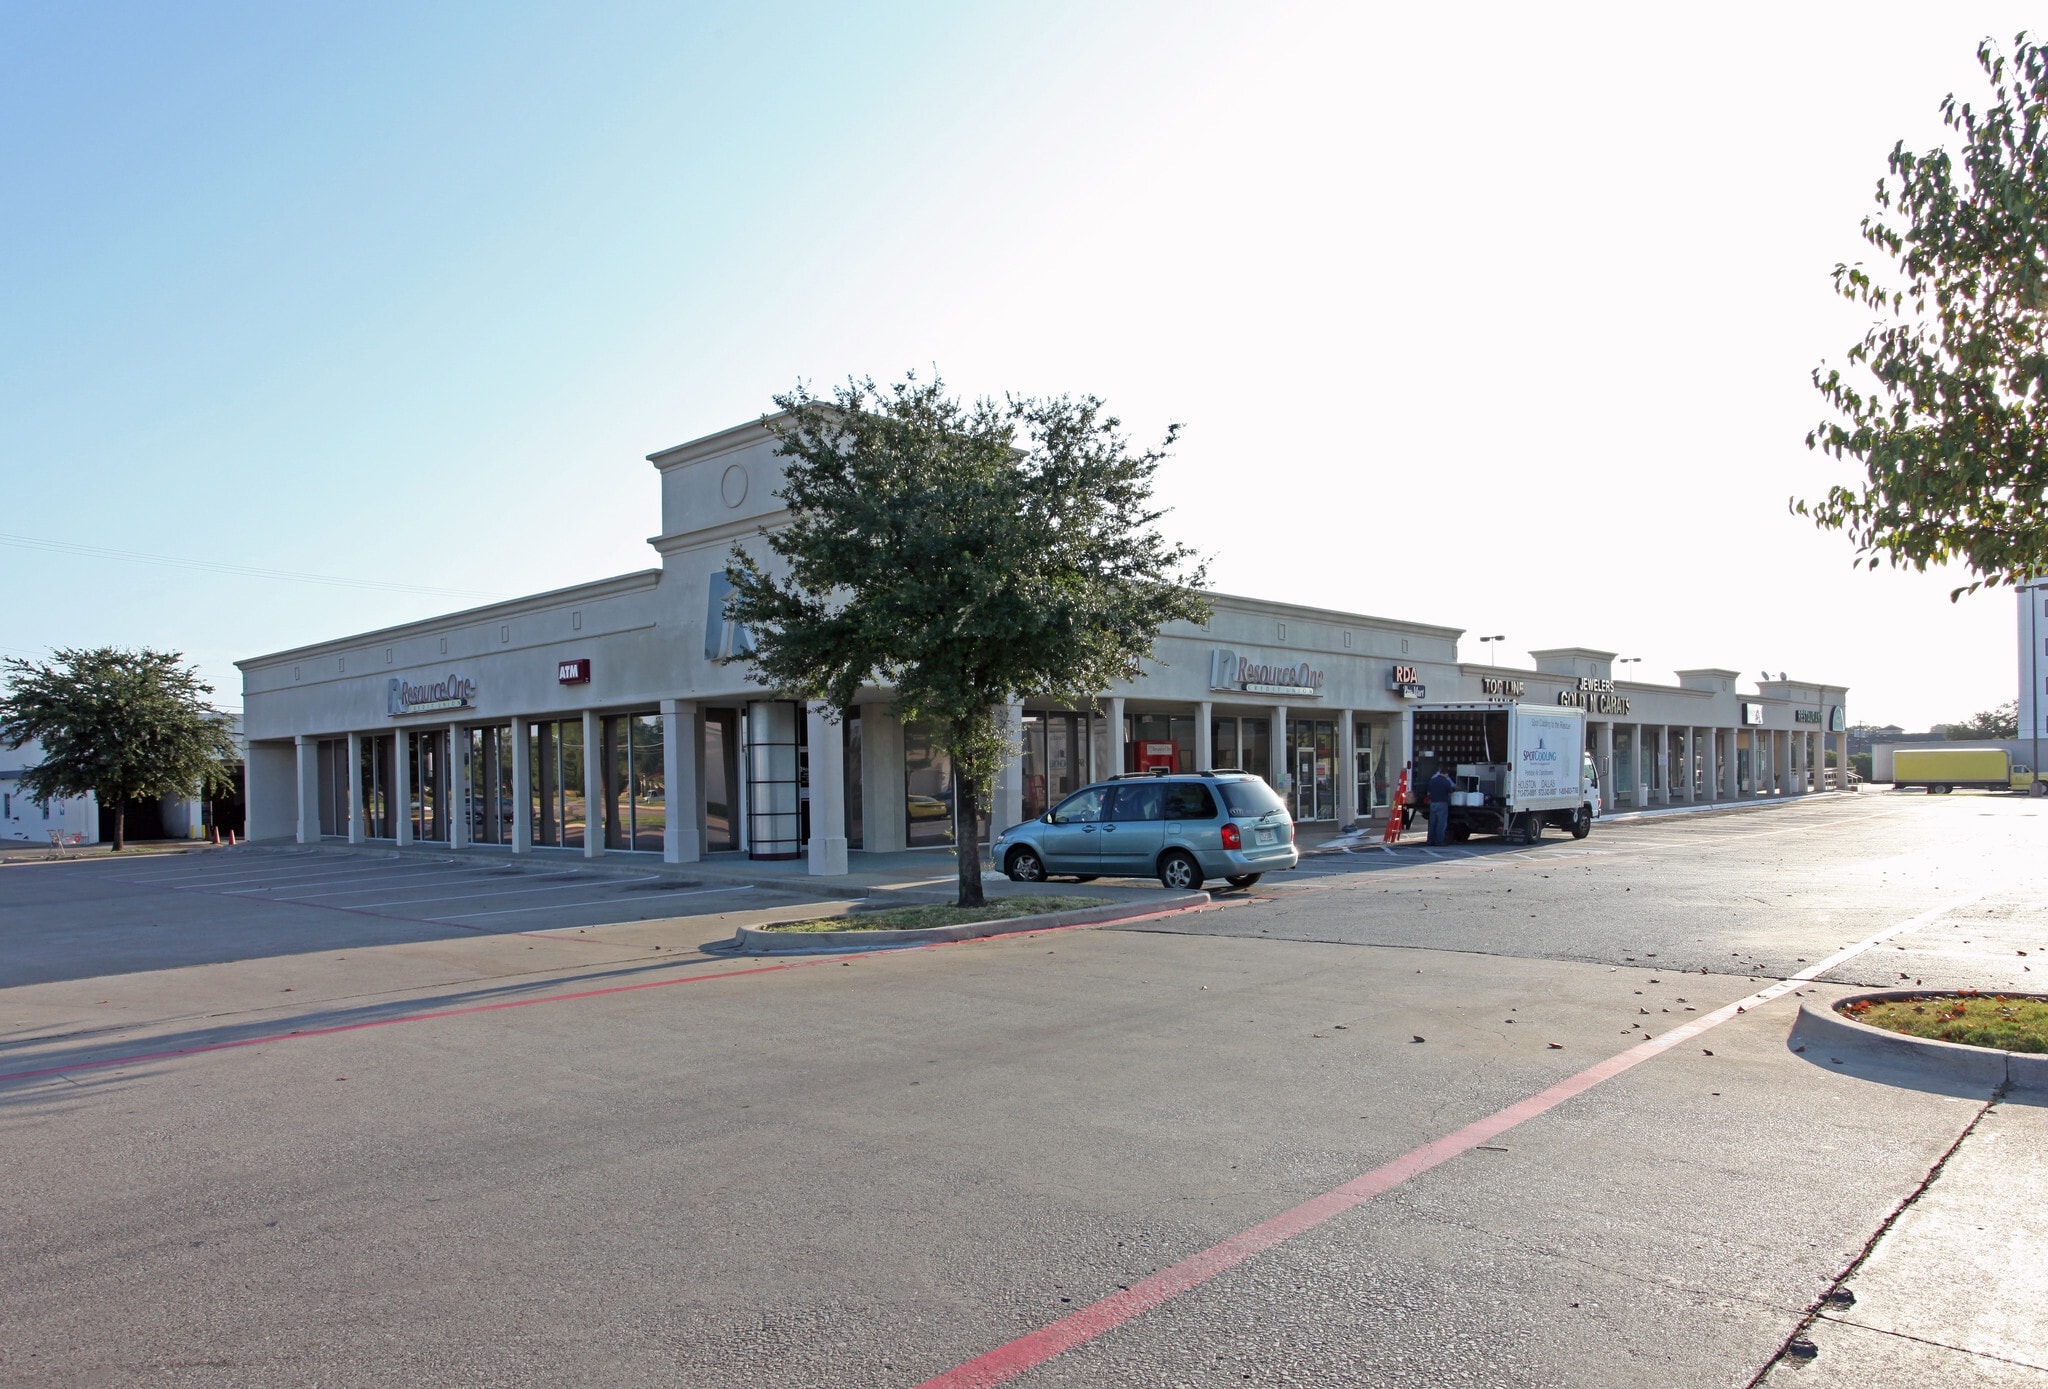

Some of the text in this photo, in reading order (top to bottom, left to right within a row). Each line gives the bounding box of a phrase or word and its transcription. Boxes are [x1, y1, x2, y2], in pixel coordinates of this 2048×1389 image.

[559, 664, 579, 680] ATM
[1396, 665, 1418, 684] RDA
[1247, 684, 1281, 693] CREDIT
[1485, 678, 1525, 698] TOP LINE
[1578, 677, 1615, 693] JEWELERS
[1561, 691, 1586, 709] GOLD
[1600, 694, 1630, 716] CARATS
